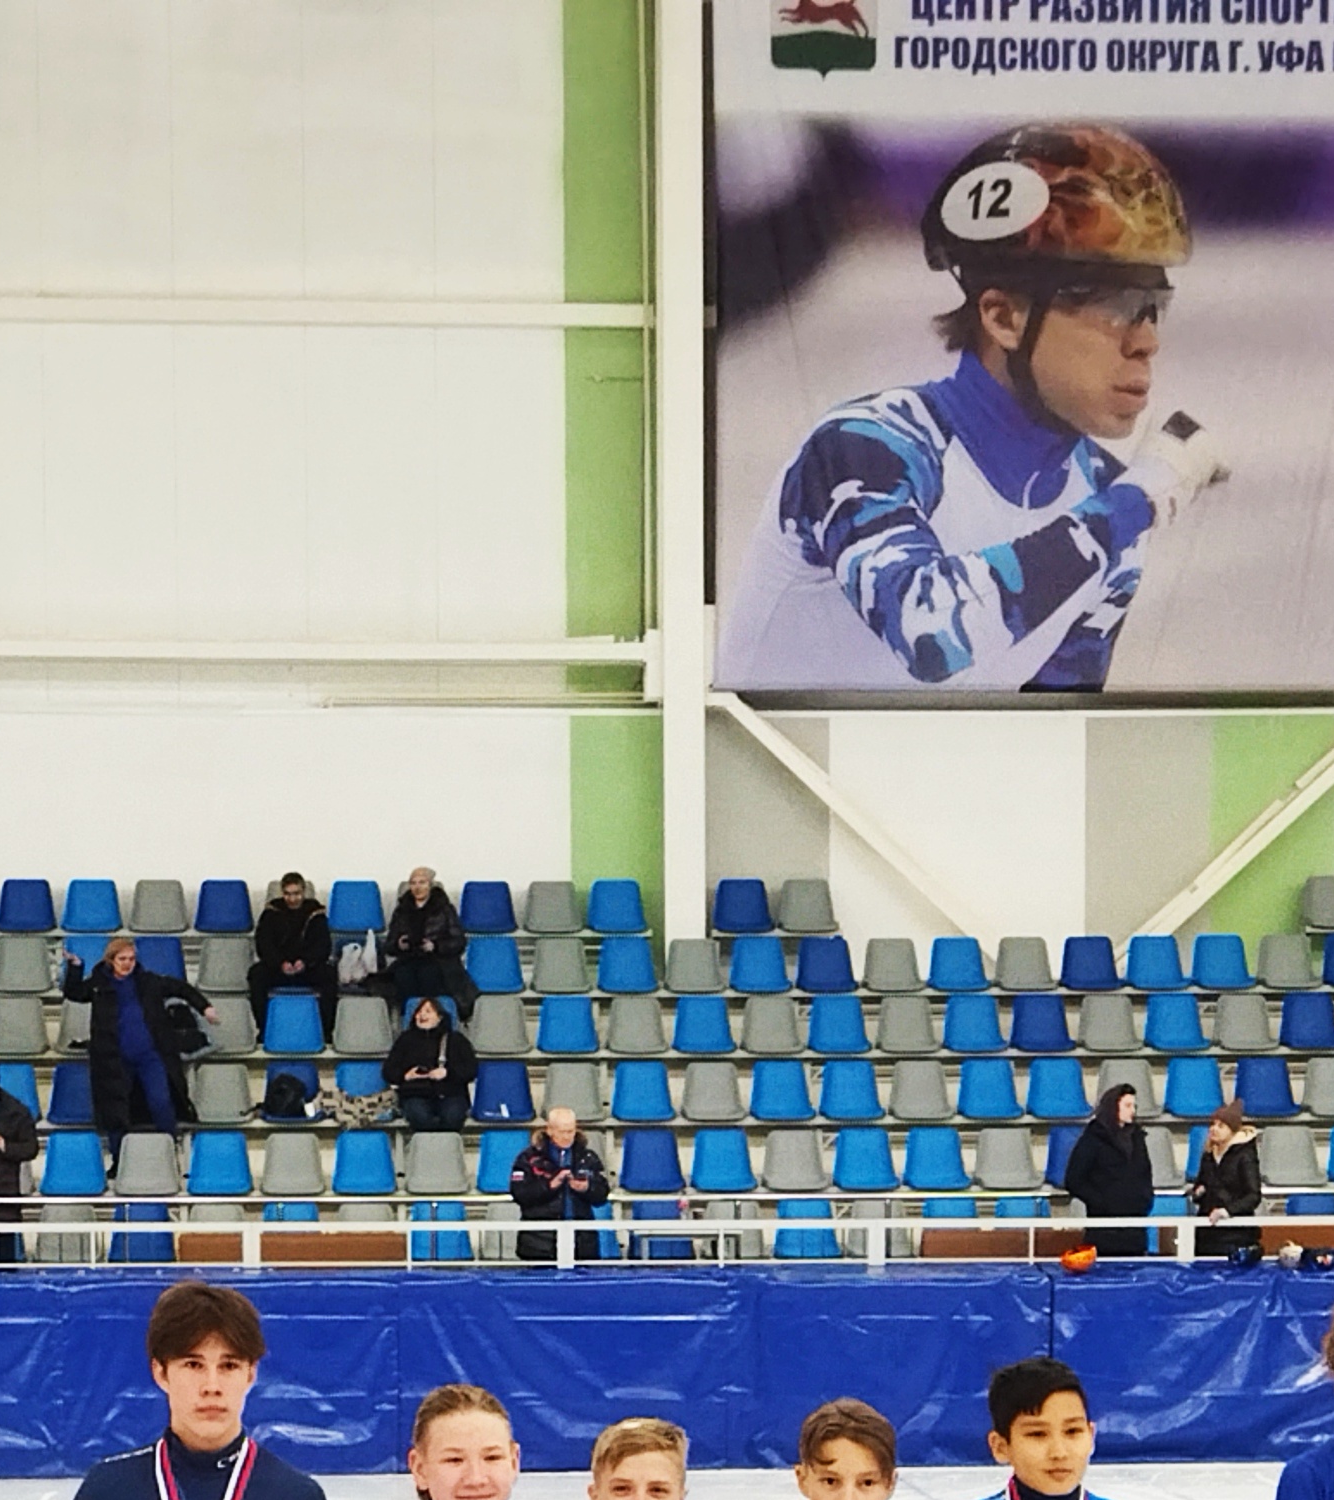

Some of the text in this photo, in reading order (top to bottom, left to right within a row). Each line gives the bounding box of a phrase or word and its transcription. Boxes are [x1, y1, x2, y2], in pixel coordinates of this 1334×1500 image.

[911, 0, 1019, 26] ЦЕНТР
[1029, 0, 1211, 24] РАЗВИТИЯ
[894, 36, 1097, 75] ГОРОДСКОГО
[1106, 38, 1220, 73] ОКРУГА
[1229, 40, 1250, 73] Г.
[1259, 40, 1325, 74] УФА
[967, 178, 1012, 220] 12
